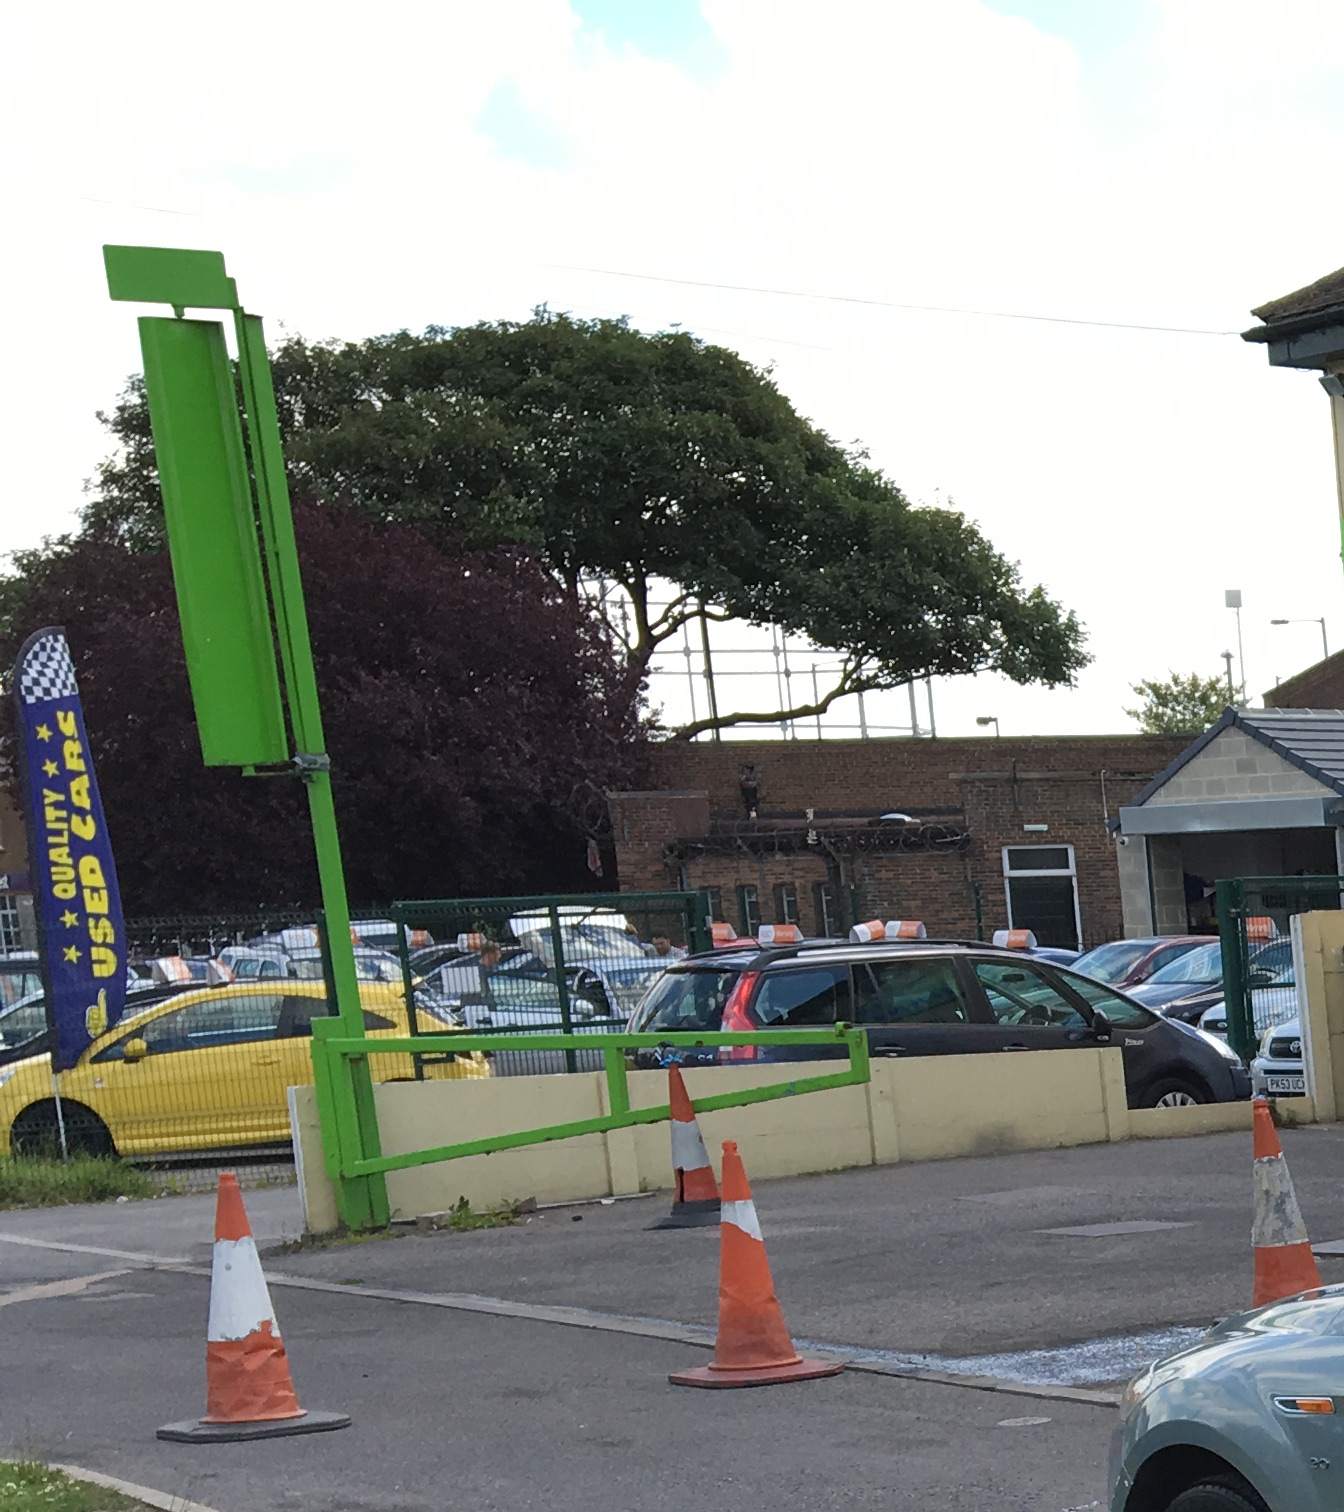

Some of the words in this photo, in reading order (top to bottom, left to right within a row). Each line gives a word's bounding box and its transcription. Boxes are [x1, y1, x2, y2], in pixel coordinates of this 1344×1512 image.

[56, 710, 97, 842] CARS
[42, 788, 78, 900] QUALITY
[78, 855, 119, 979] USED
[1270, 1079, 1290, 1089] PK53
